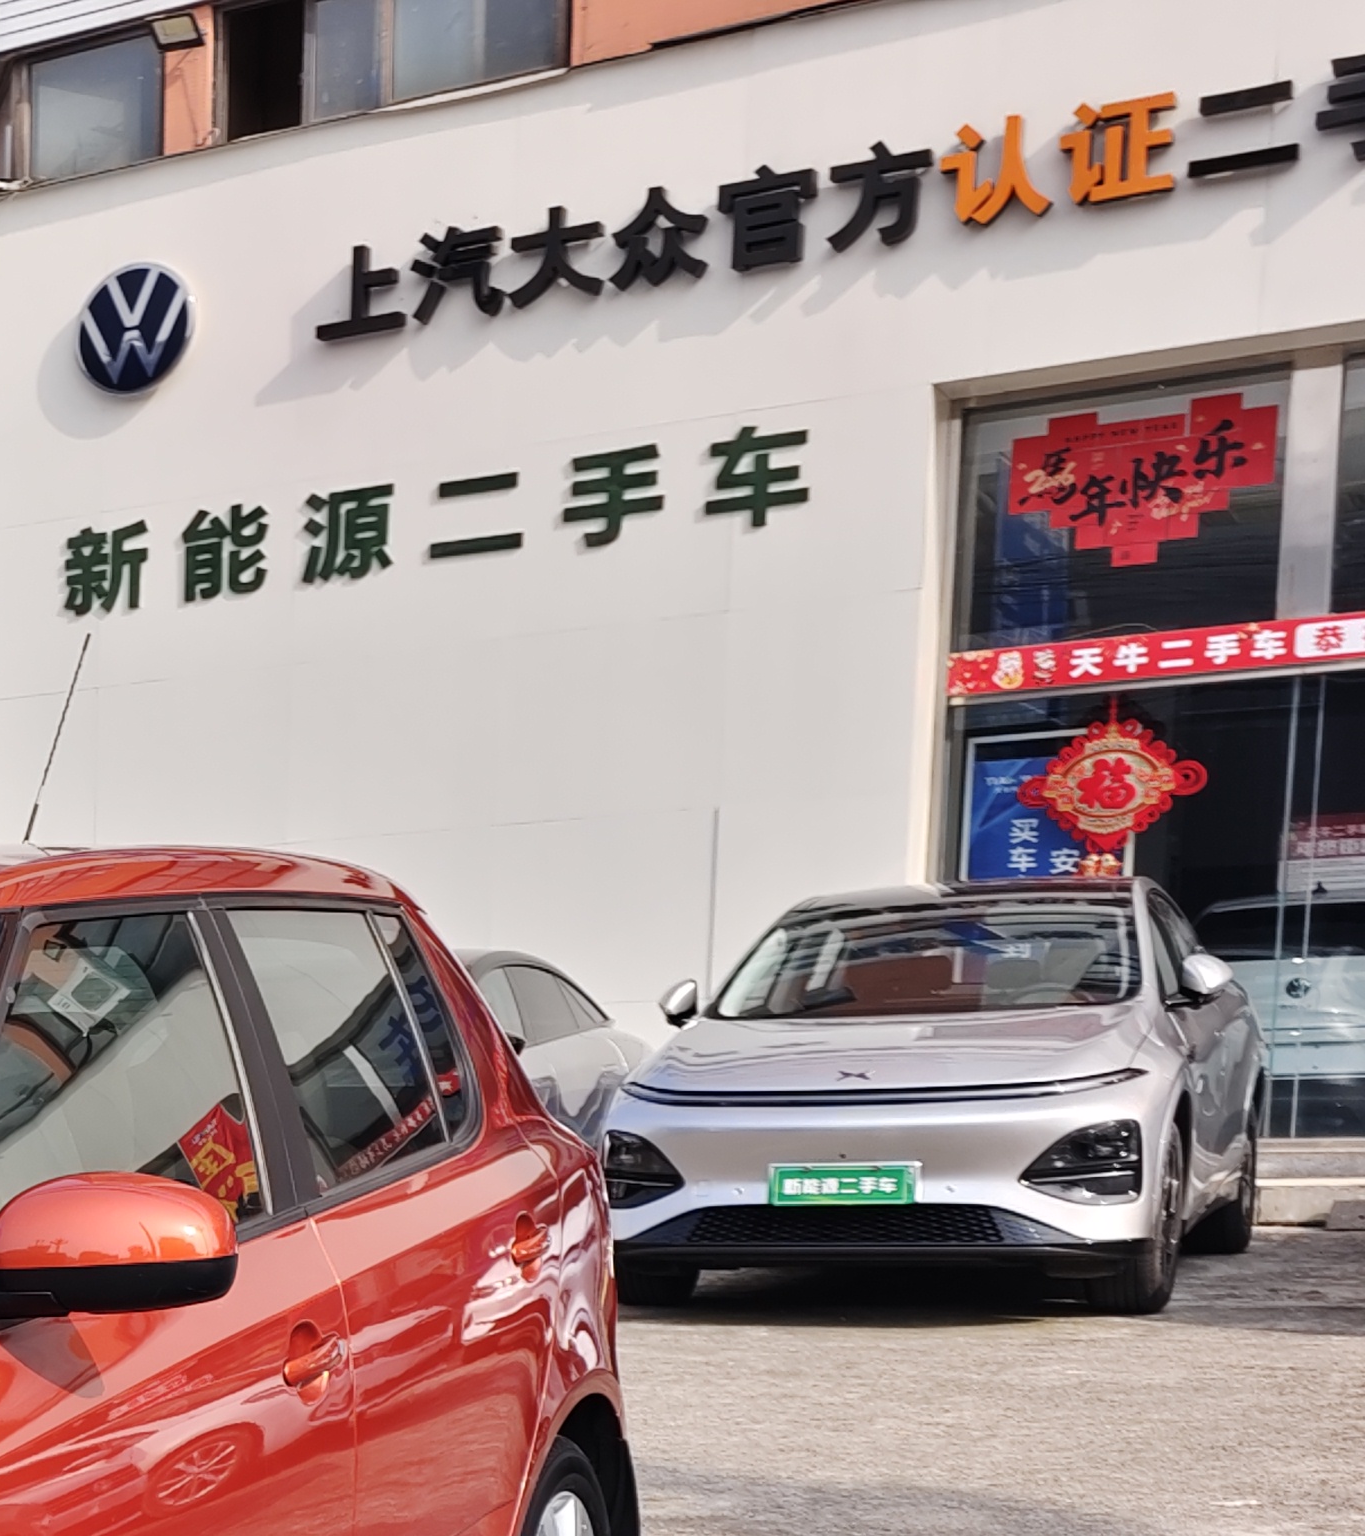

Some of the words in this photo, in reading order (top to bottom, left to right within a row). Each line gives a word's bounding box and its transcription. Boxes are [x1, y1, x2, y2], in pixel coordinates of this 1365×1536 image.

[63, 425, 812, 617] 新能源二手车
[1069, 629, 1288, 678] 天牛二手车
[1076, 757, 1137, 809] 福
[1006, 818, 1040, 878] 买车
